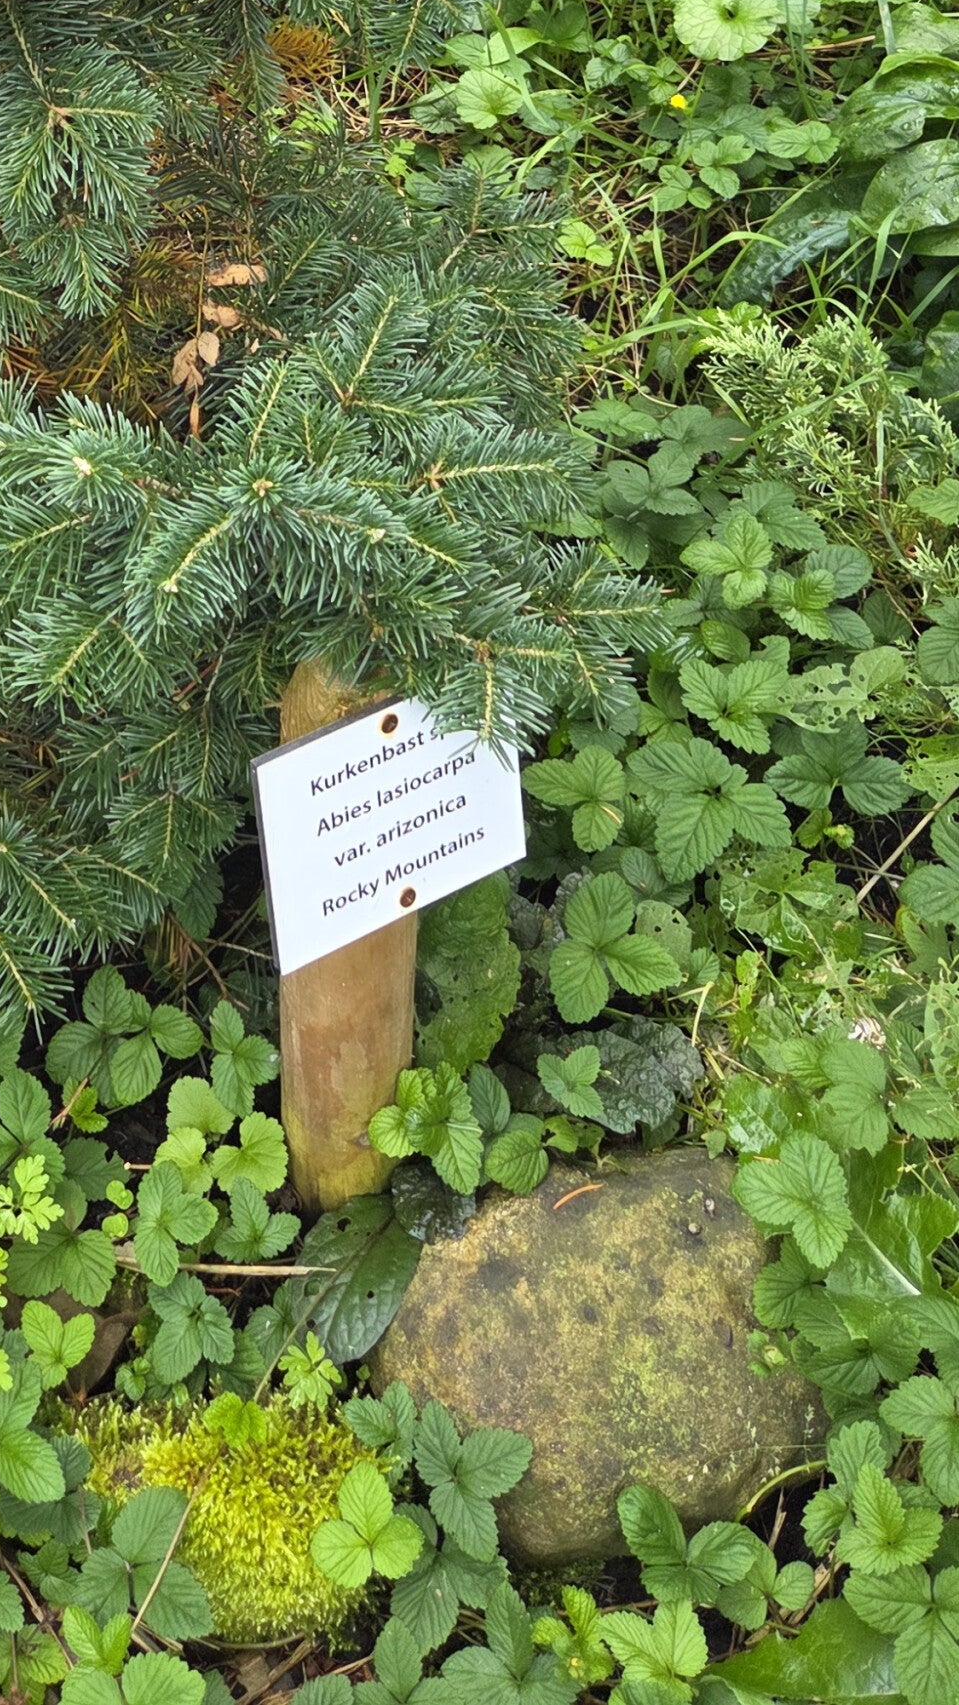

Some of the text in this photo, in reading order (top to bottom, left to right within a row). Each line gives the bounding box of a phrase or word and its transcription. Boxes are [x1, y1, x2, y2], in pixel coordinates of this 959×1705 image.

[310, 729, 425, 797] Kurkenbast
[316, 750, 476, 837] Abies lasiocarpa
[333, 794, 468, 867] var. arizonica
[322, 826, 486, 917] Rocky Mountains
